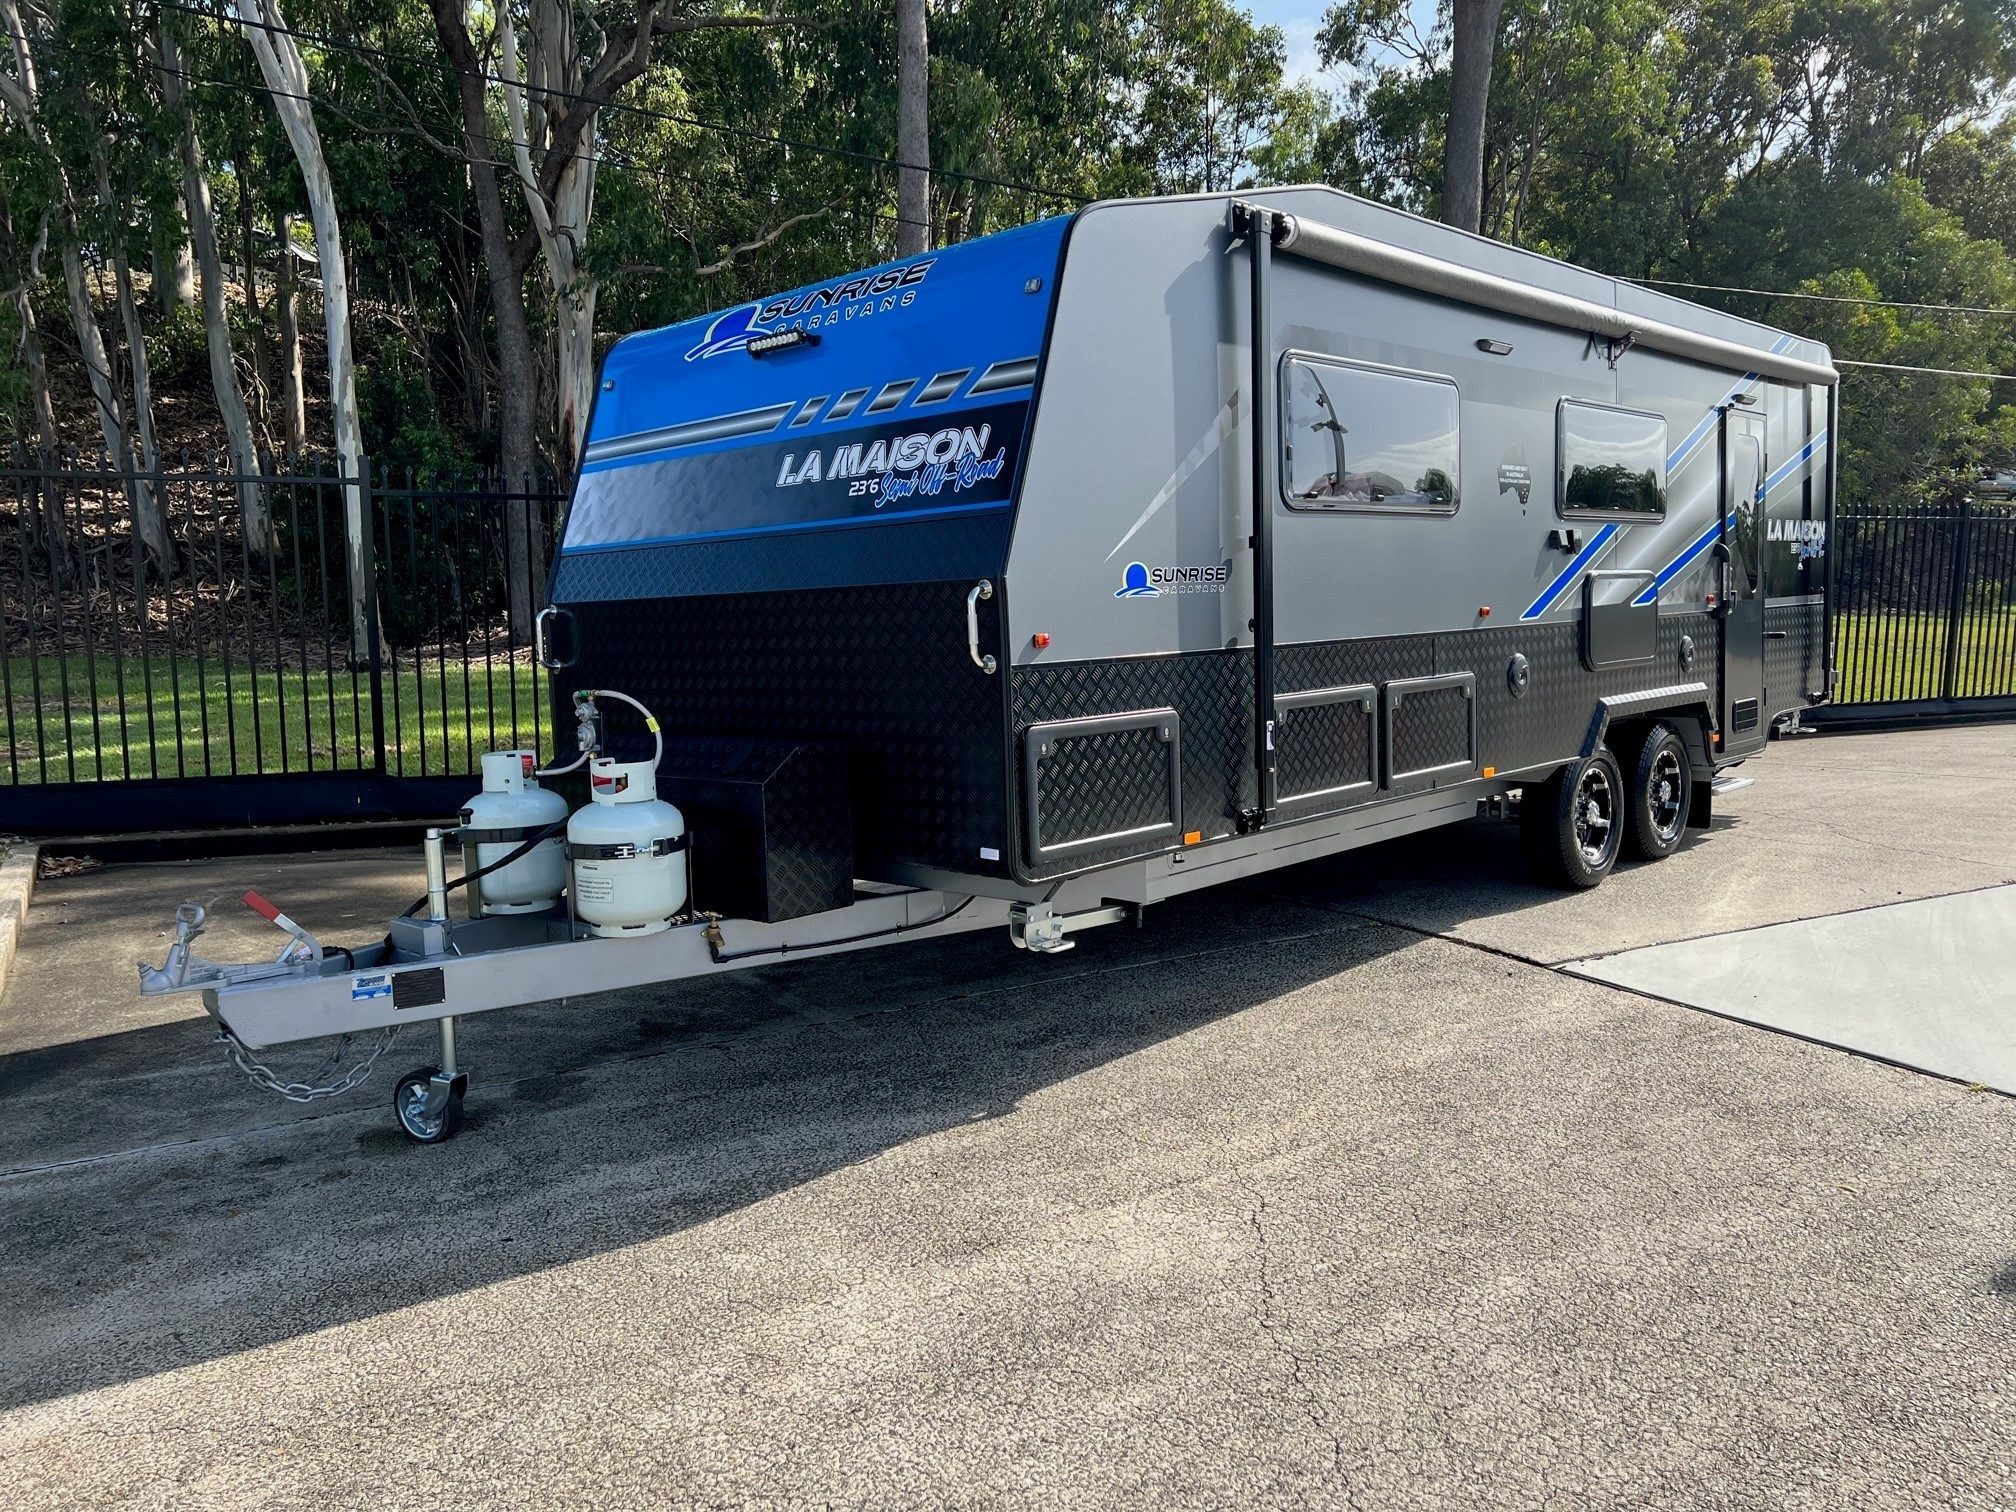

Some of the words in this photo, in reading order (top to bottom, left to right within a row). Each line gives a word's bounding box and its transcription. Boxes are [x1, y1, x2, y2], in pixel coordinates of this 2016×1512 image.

[758, 258, 938, 323] SUNRISE
[776, 450, 821, 487] LA
[826, 423, 991, 480] MAISON
[875, 470, 918, 508] Semi
[919, 447, 1005, 495] Off-Road
[1767, 519, 1782, 541] LA
[1783, 520, 1826, 541] MAISON
[1151, 566, 1226, 584] SUNRISE
[1162, 584, 1225, 594] CARAVANS
